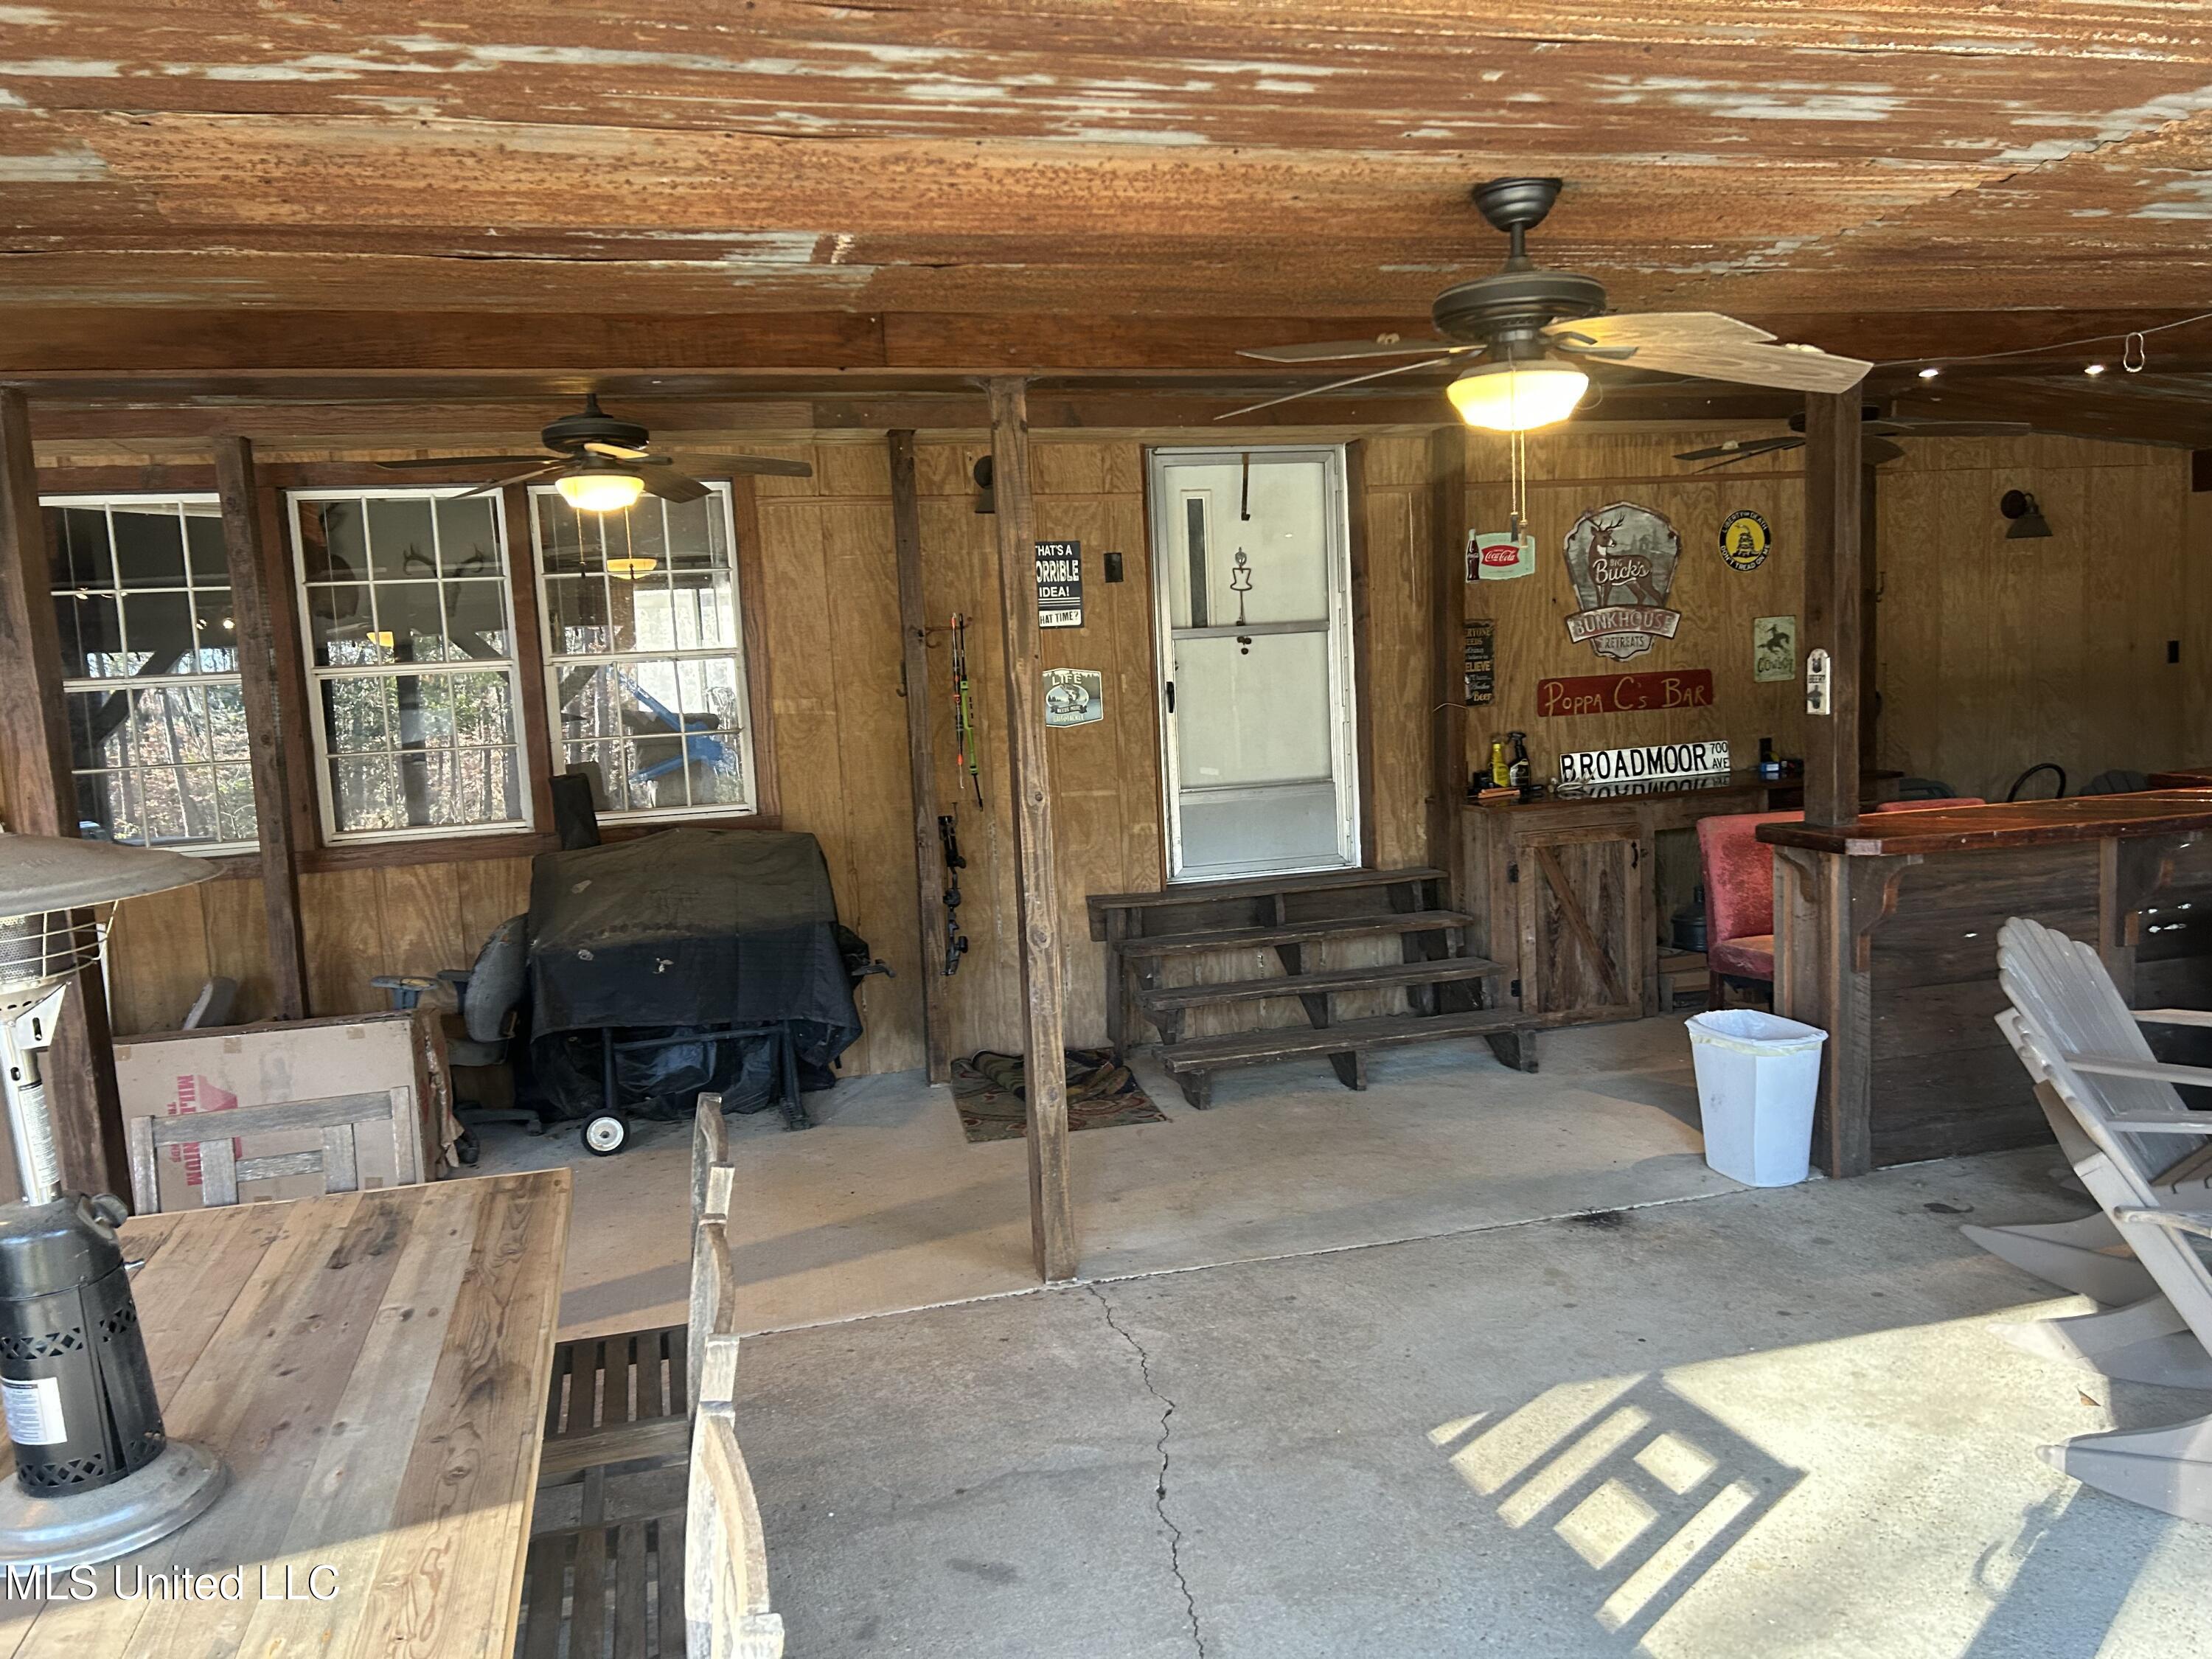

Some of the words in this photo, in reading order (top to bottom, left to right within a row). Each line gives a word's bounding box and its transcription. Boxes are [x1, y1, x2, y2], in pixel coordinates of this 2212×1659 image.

[1065, 545, 1073, 555] A
[1036, 560, 1079, 582] ORRIBLE
[1593, 558, 1649, 584] Buck's
[1040, 586, 1070, 597] IDEA!
[1040, 614, 1053, 625] HAT
[1055, 611, 1079, 622] TIME?
[1573, 610, 1674, 635] BUNKHOUSE
[1604, 636, 1645, 649] RETREATS
[1466, 661, 1491, 672] ELIEVE
[1051, 674, 1082, 686] LIFE
[1711, 742, 1728, 754] 700
[1561, 743, 1708, 782] BROADMOOR
[1712, 757, 1731, 769] AVE
[177, 1075, 203, 1186] MILLNIUM
